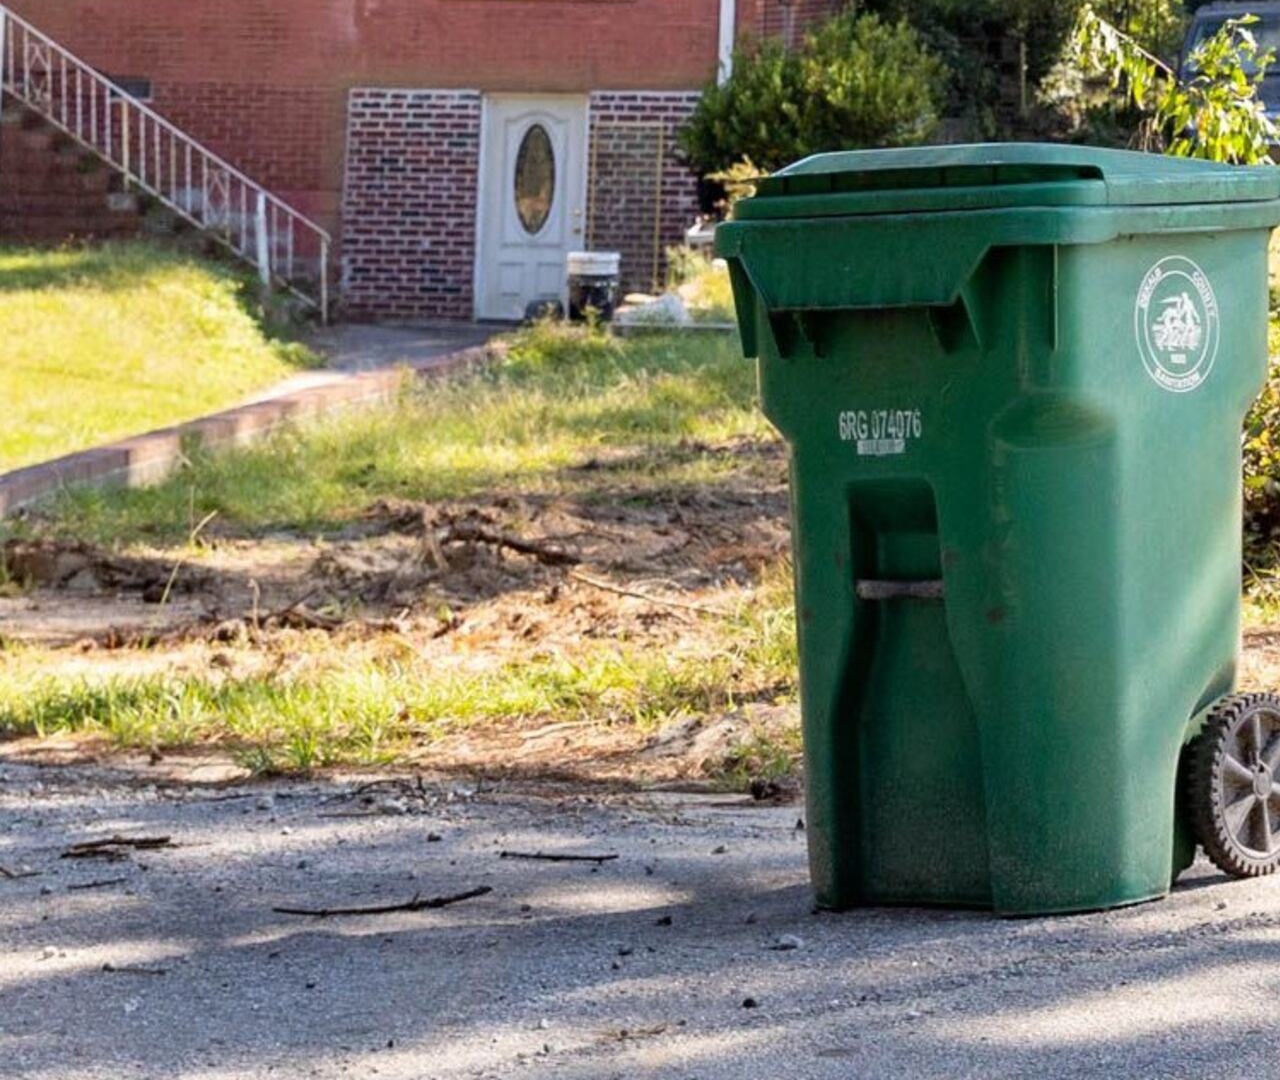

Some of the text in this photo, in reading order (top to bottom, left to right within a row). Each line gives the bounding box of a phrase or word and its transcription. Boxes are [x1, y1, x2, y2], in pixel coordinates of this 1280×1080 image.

[1191, 270, 1216, 317] COUNTY
[838, 409, 922, 441] 6RG 074076
